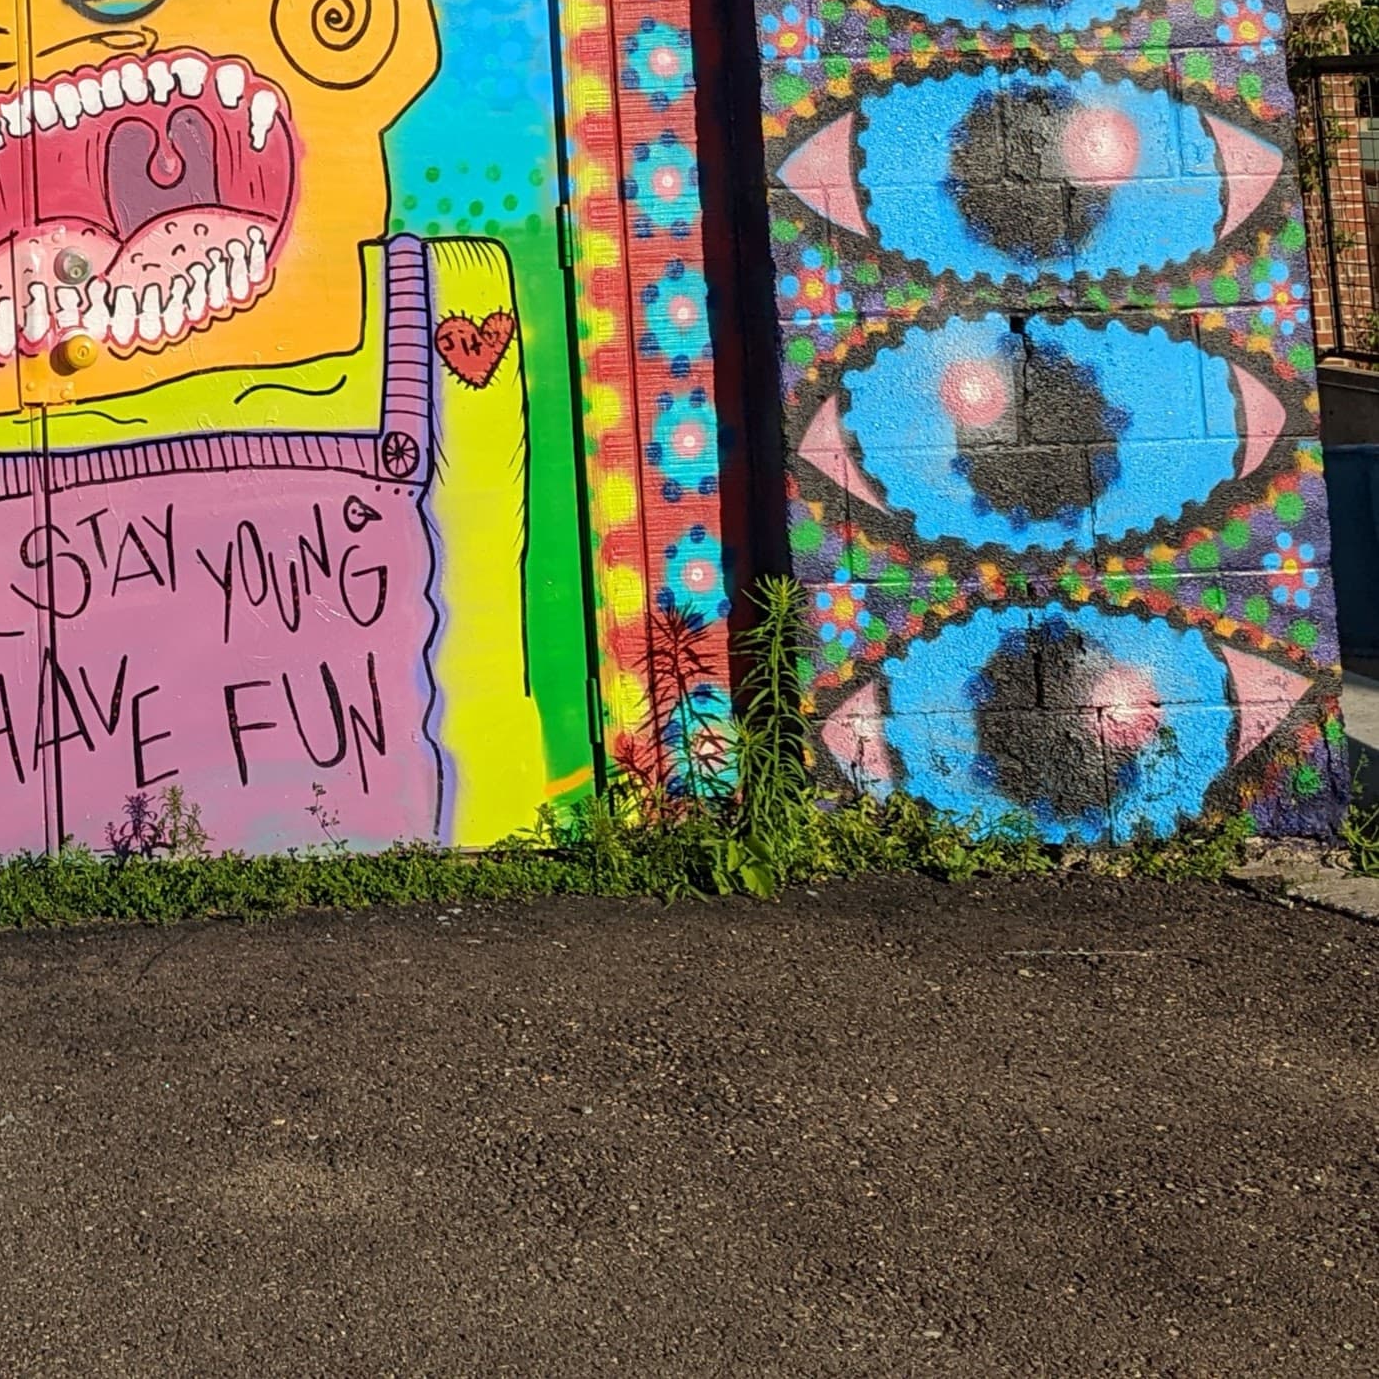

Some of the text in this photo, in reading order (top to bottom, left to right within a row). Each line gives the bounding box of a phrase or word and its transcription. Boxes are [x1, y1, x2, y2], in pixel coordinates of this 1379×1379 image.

[10, 503, 389, 644] STAY YOUNG
[222, 652, 387, 794] FUN
